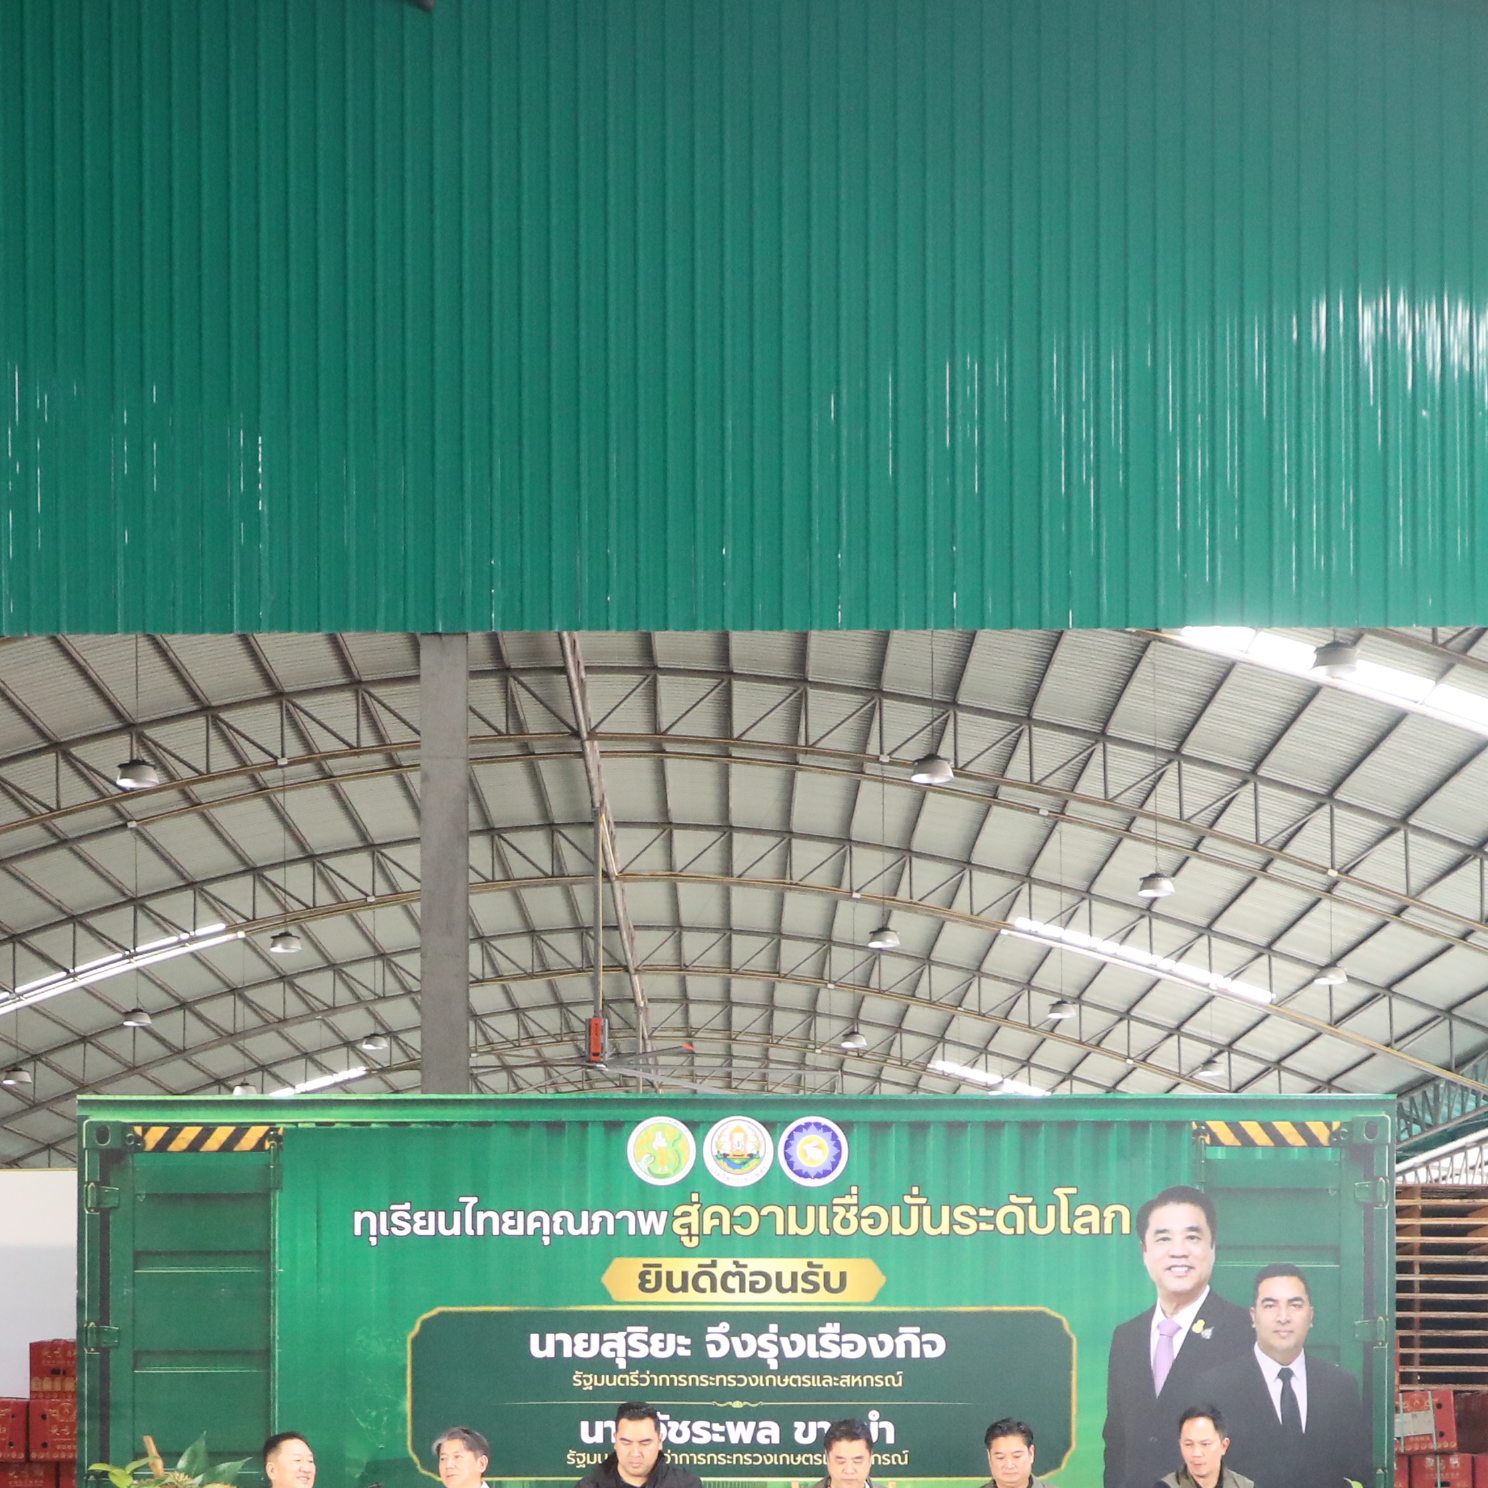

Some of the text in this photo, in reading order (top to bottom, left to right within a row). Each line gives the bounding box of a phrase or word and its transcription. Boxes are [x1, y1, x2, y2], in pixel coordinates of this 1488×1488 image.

[352, 1185, 1132, 1249] ทุเรียนไทยคุณภาพ สู่ความเชื่อมั่นระดับโลก
[637, 1259, 848, 1295] ยินดีต้อนรับ
[529, 1321, 947, 1370] นายสุริยะ จึงรุ่งเรืองกิจ
[572, 1370, 904, 1390] รัฐมนตรีว่าการกระทรวงเกษตรและสหกรณ์
